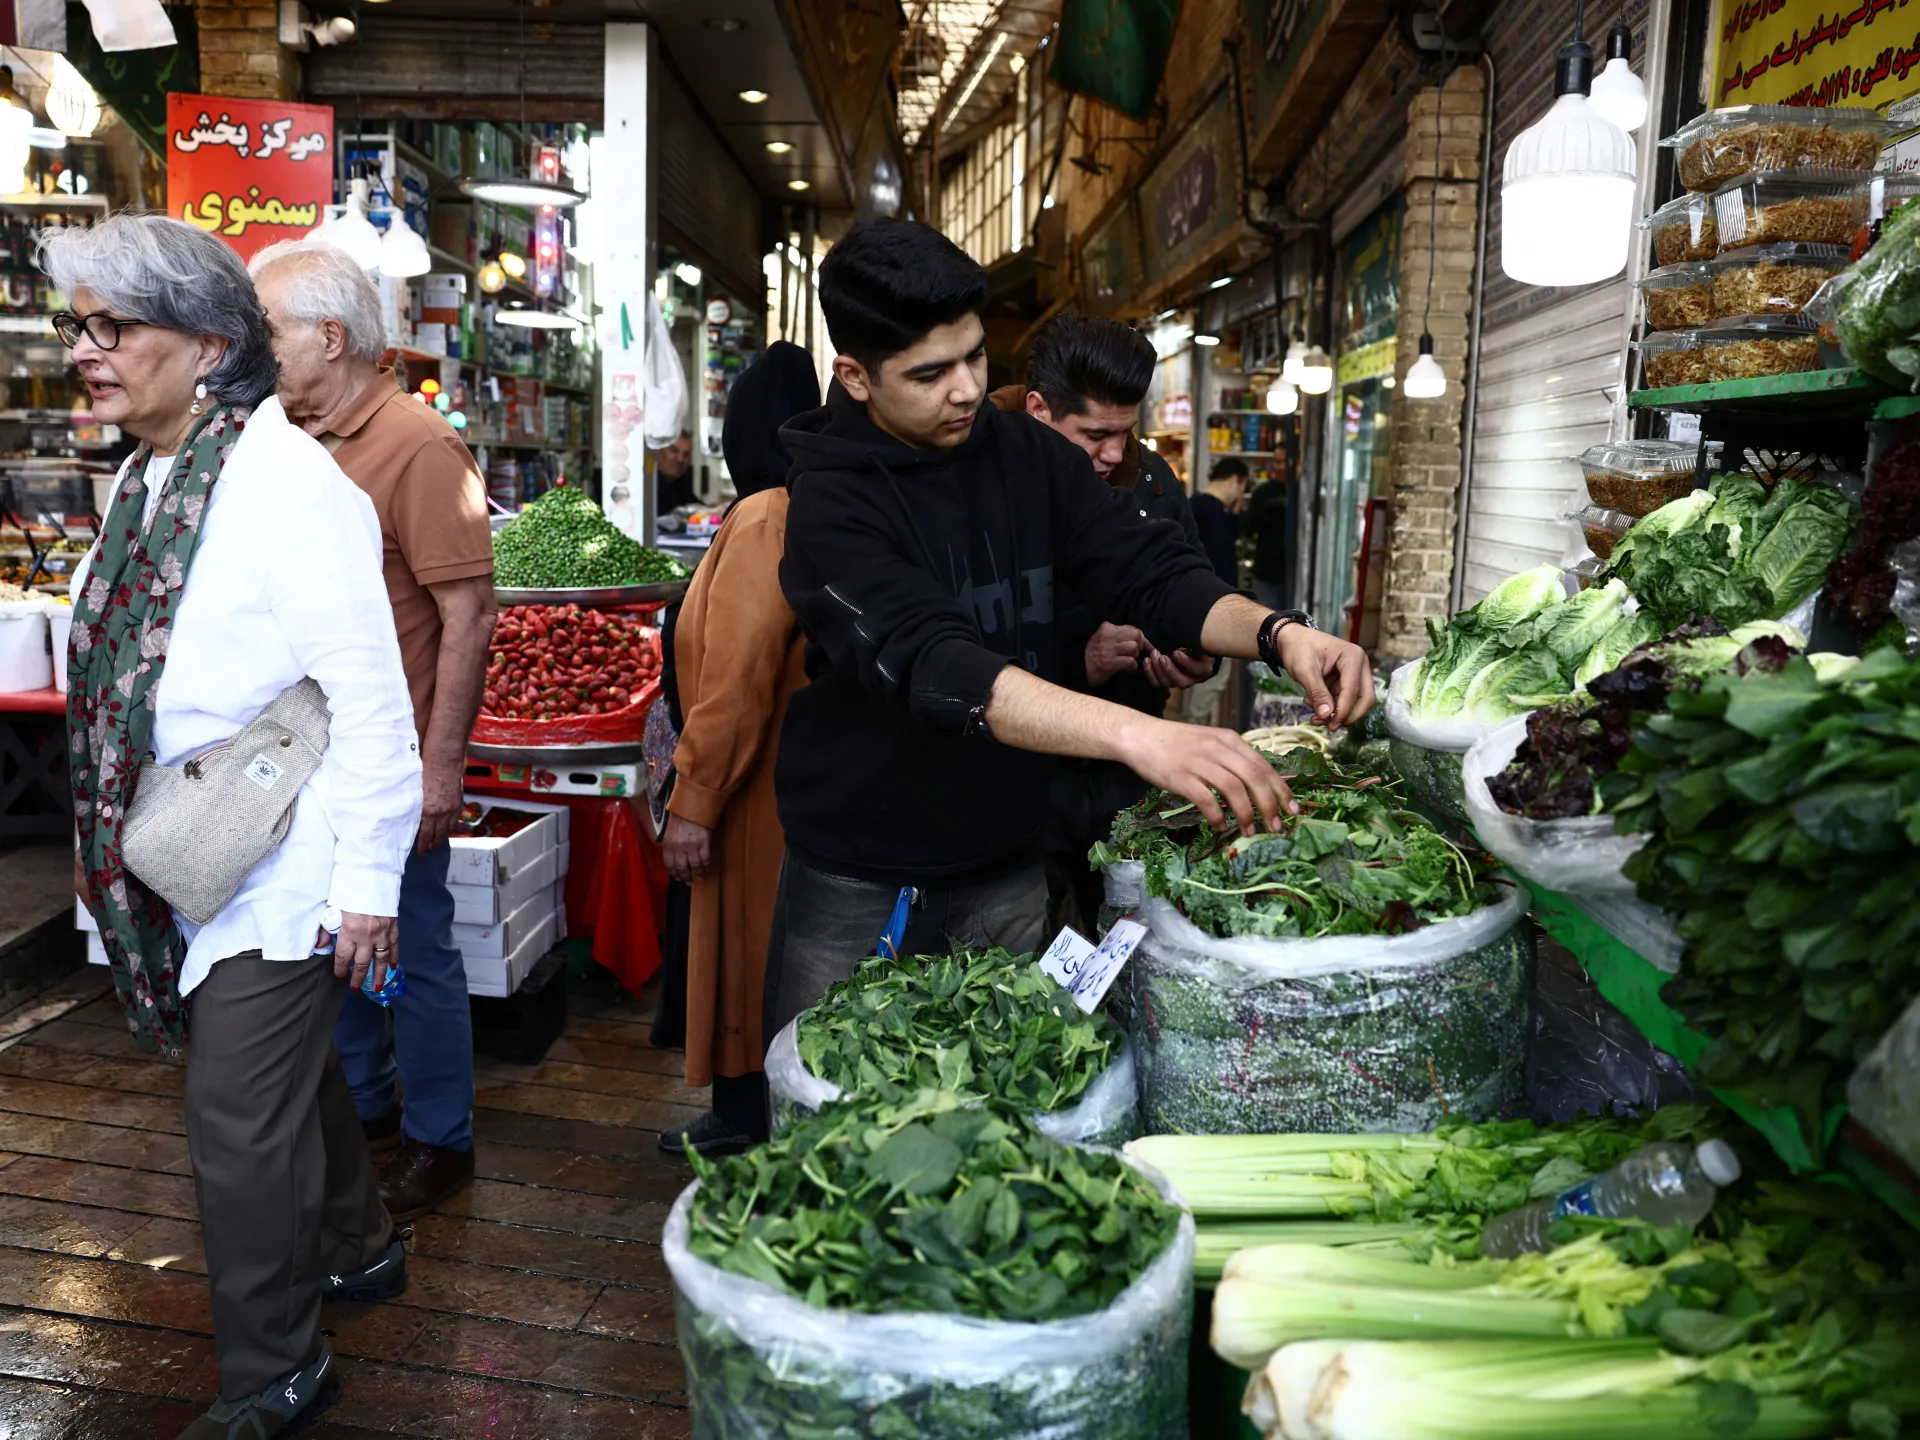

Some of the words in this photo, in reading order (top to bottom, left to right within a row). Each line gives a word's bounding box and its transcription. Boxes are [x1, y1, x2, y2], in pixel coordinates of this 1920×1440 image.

[1770, 12, 1839, 67] پذیرفته
[1743, 54, 1769, 90] می
[174, 112, 250, 159] پخش
[253, 118, 326, 161] مرکز
[183, 185, 318, 237] سمنوی
